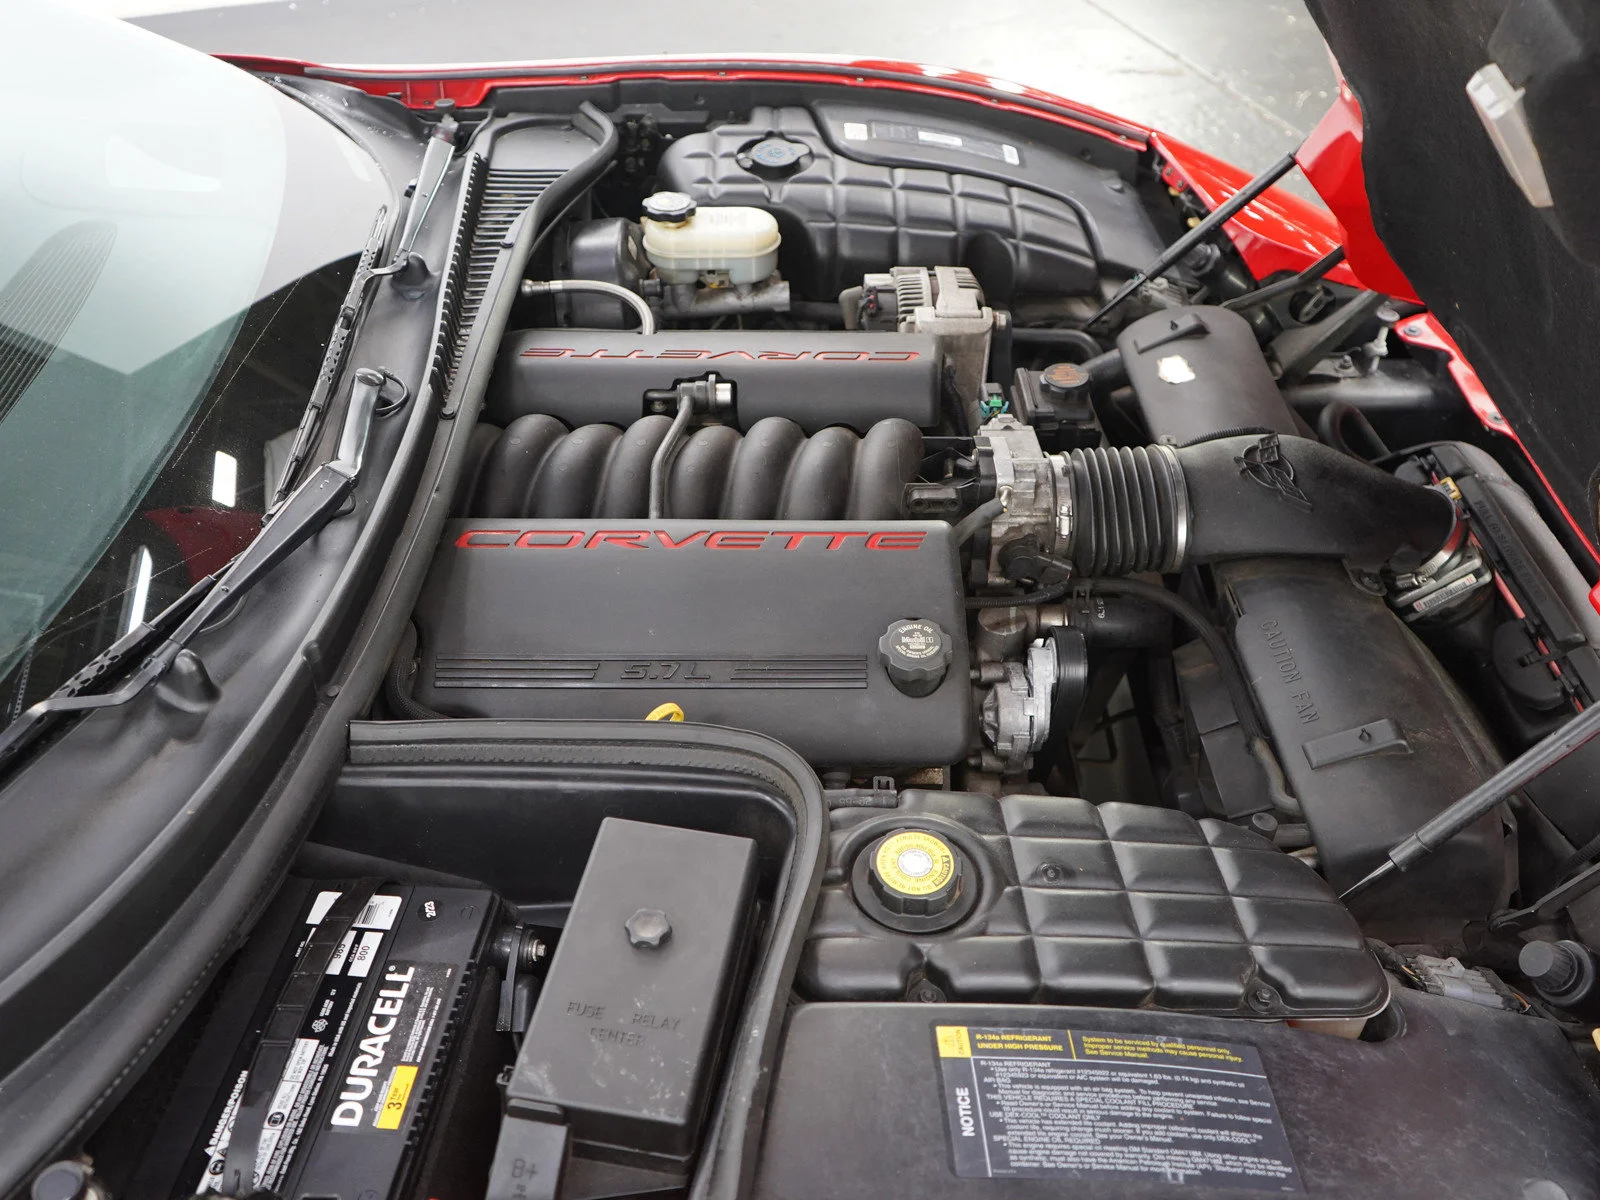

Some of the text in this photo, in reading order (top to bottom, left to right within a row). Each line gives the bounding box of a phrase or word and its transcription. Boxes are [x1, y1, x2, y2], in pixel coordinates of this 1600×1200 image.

[520, 347, 920, 362] CORVETTE
[455, 530, 927, 551] CORVETTE
[898, 624, 922, 633] ENGINE
[620, 662, 712, 680] 5.7L
[1260, 618, 1320, 724] CAUTION FAN
[424, 900, 436, 918] 2/23
[357, 945, 370, 961] 800
[566, 1001, 682, 1030] FUSE RELAY
[589, 1027, 648, 1047] CENTER
[999, 1034, 1052, 1042] REFRIGERANT
[331, 966, 415, 1127] DURACELL
[1023, 1043, 1064, 1051] PRESSURE
[956, 1088, 976, 1136] NOTICE
